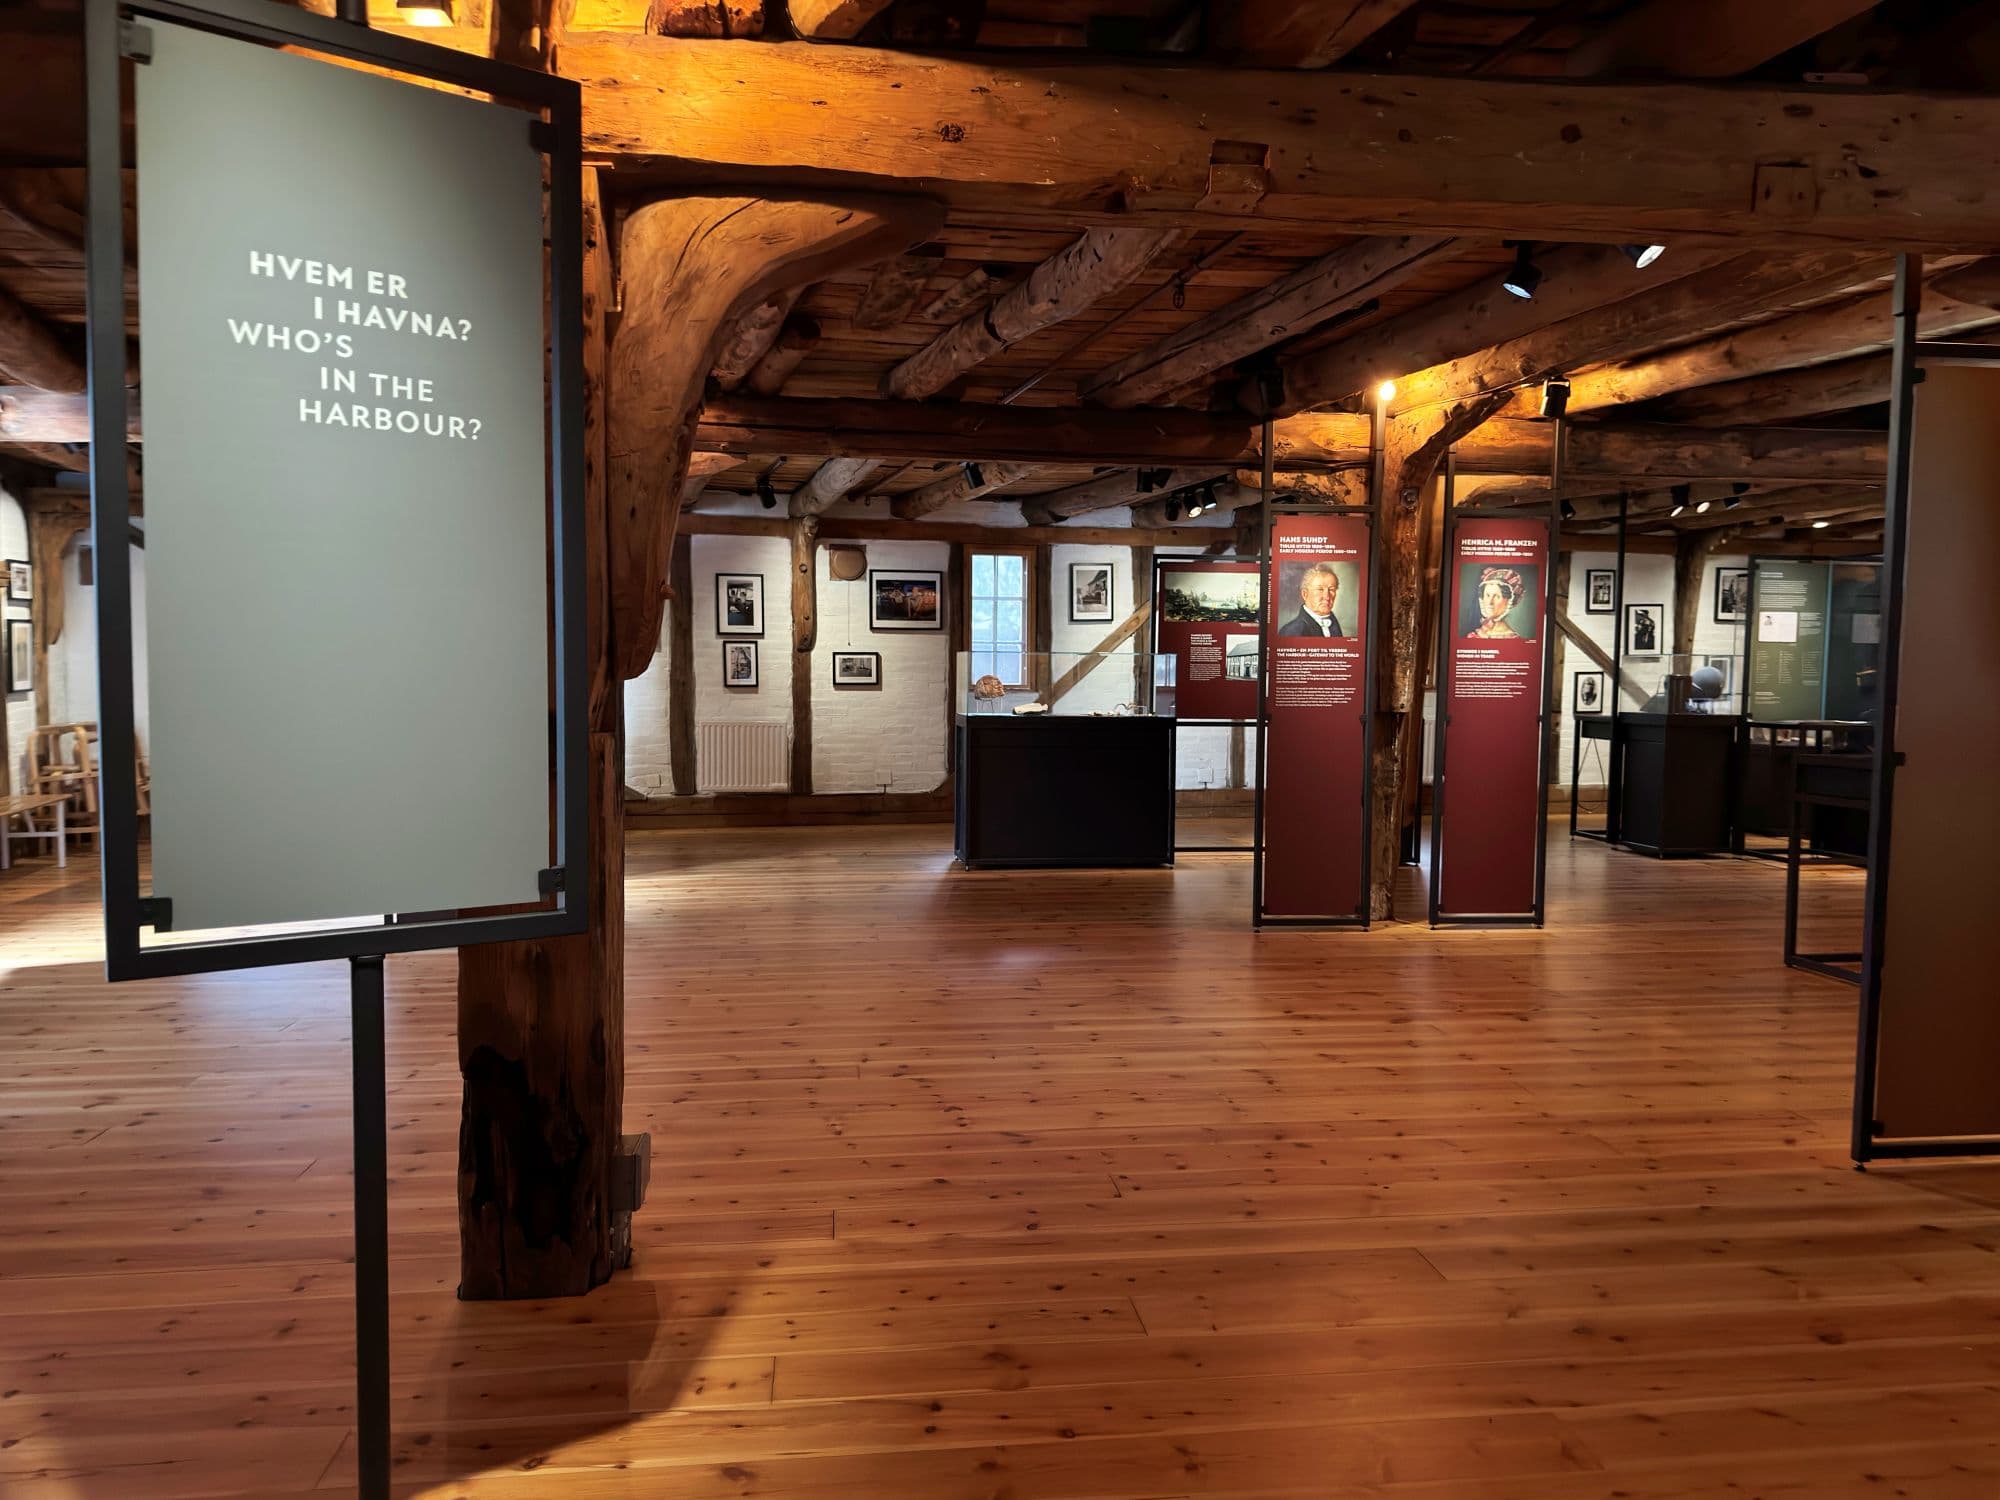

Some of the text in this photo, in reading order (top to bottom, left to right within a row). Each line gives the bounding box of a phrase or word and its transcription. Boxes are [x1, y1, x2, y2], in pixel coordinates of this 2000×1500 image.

[250, 250, 408, 298] HVEM ER
[227, 318, 353, 358] WHO'S
[313, 296, 472, 341] I HAVNA?
[320, 366, 434, 402] IN THE
[300, 398, 482, 440] HARBOUR?
